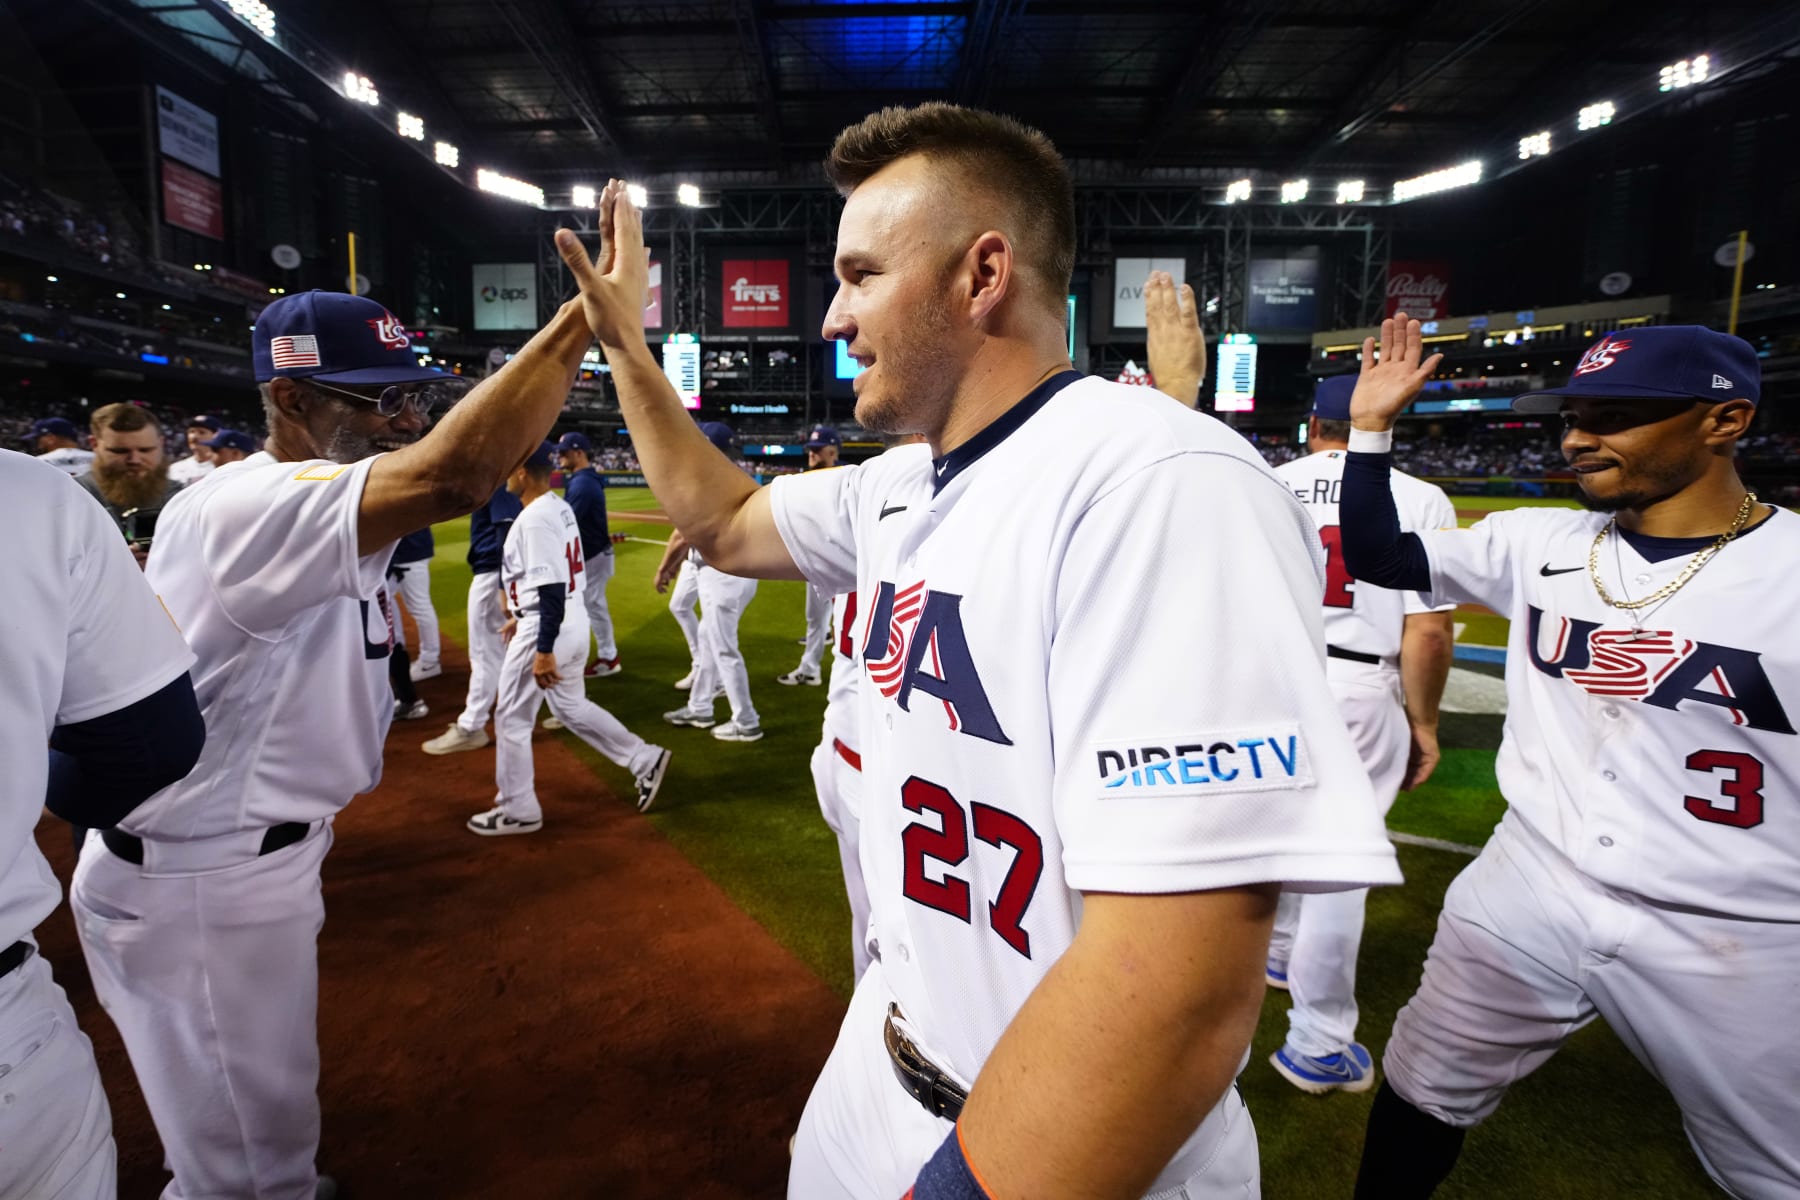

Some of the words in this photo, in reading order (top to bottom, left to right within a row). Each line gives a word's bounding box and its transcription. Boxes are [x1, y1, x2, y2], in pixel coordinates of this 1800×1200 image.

[500, 288, 528, 303] aps
[1386, 273, 1448, 302] Bally
[565, 536, 583, 593] 14
[862, 580, 1014, 746] USA
[1527, 603, 1799, 736] USA
[1096, 735, 1297, 789] DIRECTV
[1684, 748, 1765, 830] 3
[901, 775, 1044, 961] 27
